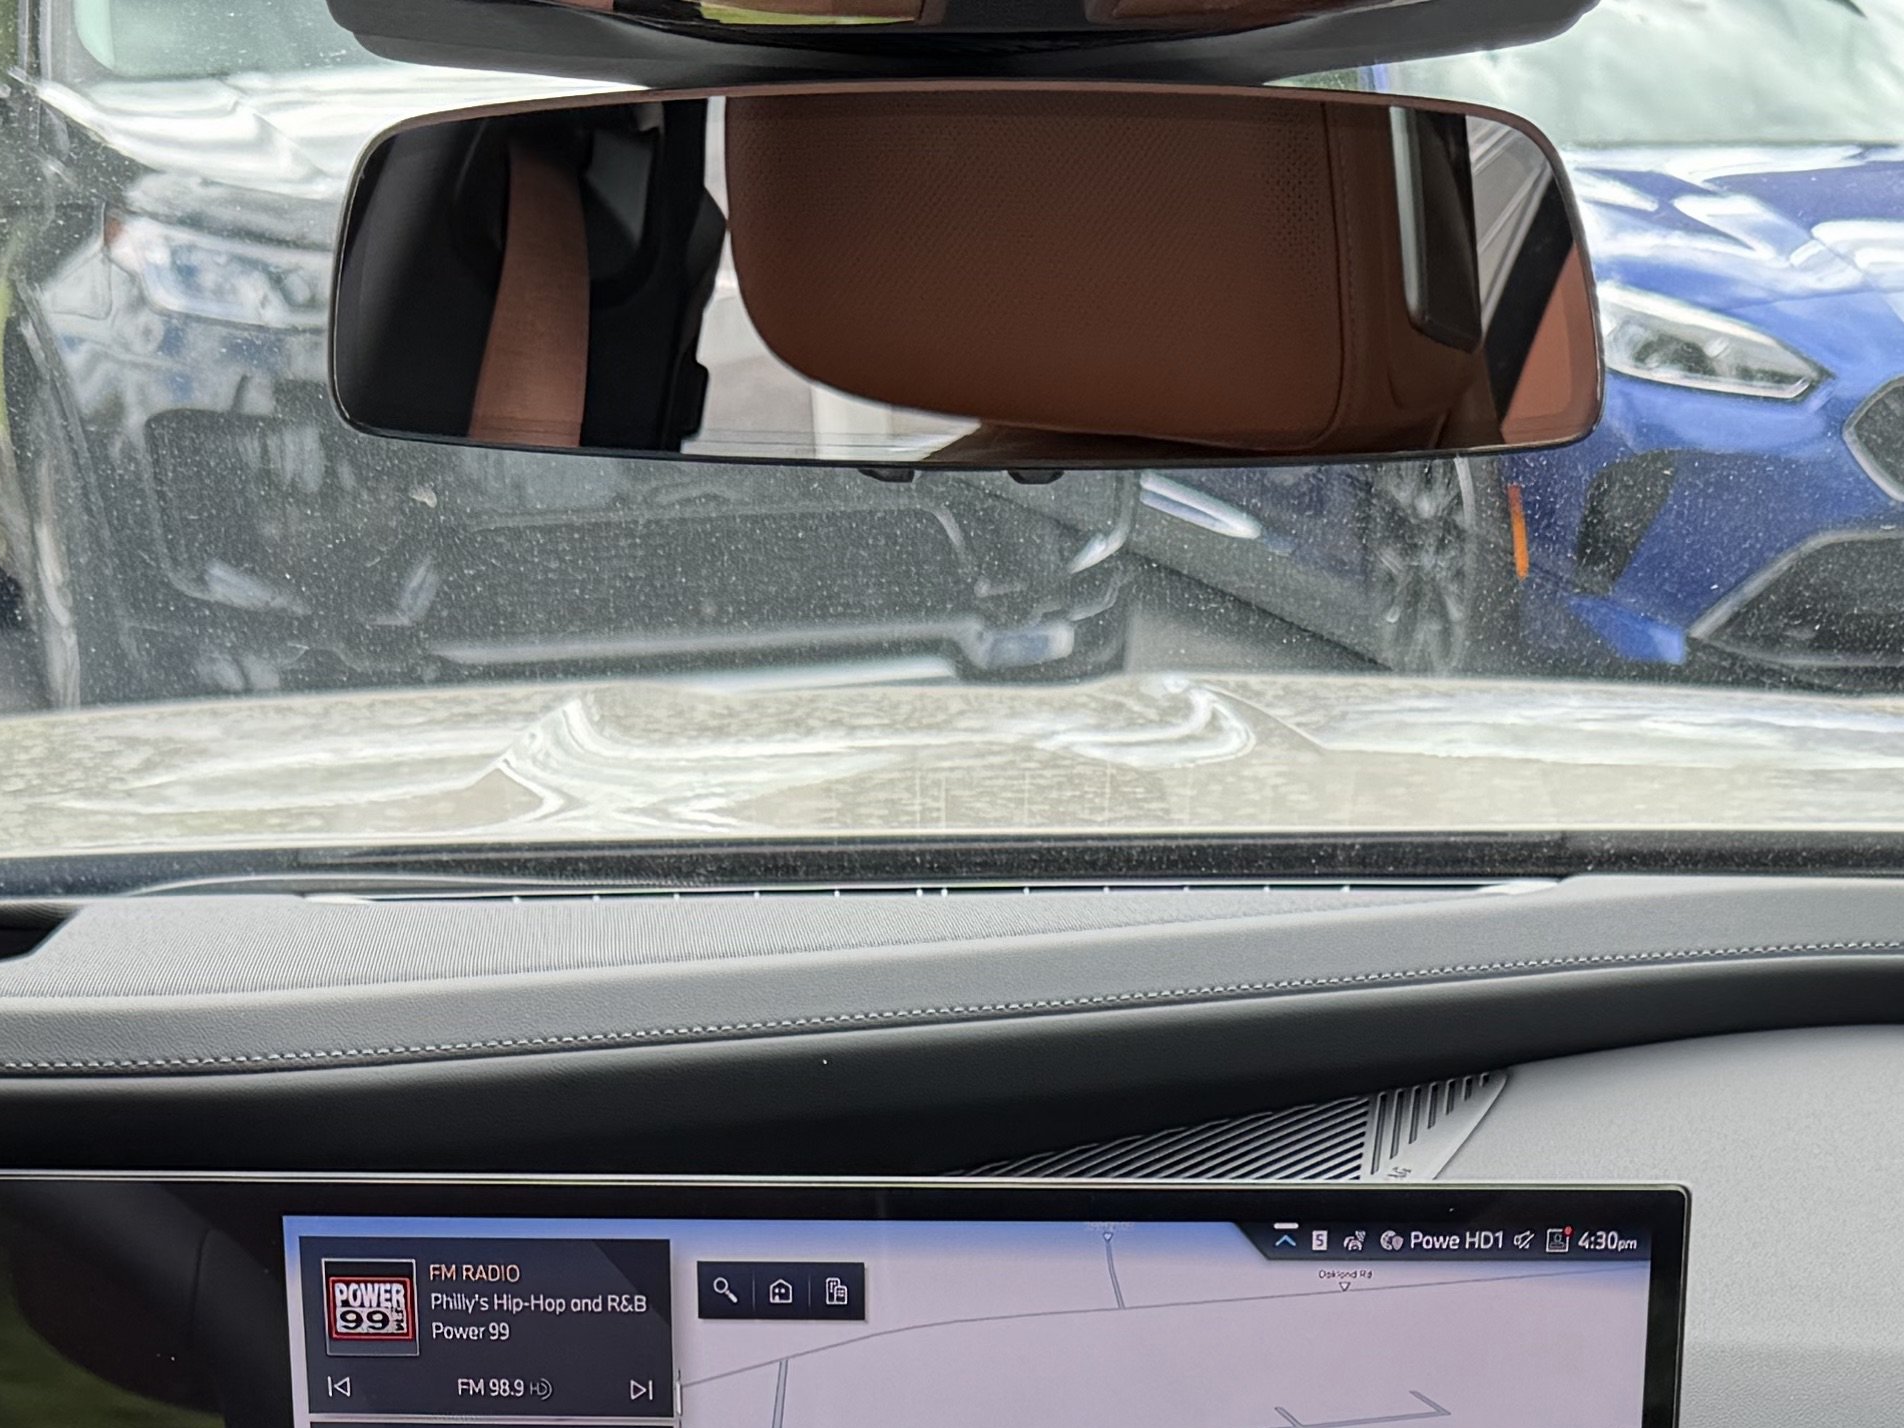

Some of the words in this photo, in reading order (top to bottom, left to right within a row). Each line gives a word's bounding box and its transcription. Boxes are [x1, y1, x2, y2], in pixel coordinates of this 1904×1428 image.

[1410, 1230, 1460, 1251] Powe
[1465, 1230, 1504, 1251] HD1
[429, 1263, 456, 1282] FM
[462, 1263, 521, 1283] RADIO
[333, 1282, 406, 1309] POWER
[430, 1292, 490, 1315] Philly's
[493, 1293, 566, 1316] Hip-Hop
[570, 1295, 603, 1313] and
[607, 1295, 648, 1313] R&B
[339, 1309, 391, 1331] 99
[431, 1321, 486, 1340] Power
[488, 1322, 511, 1341] 99
[457, 1377, 485, 1397] FM
[488, 1378, 525, 1398] 98.9
